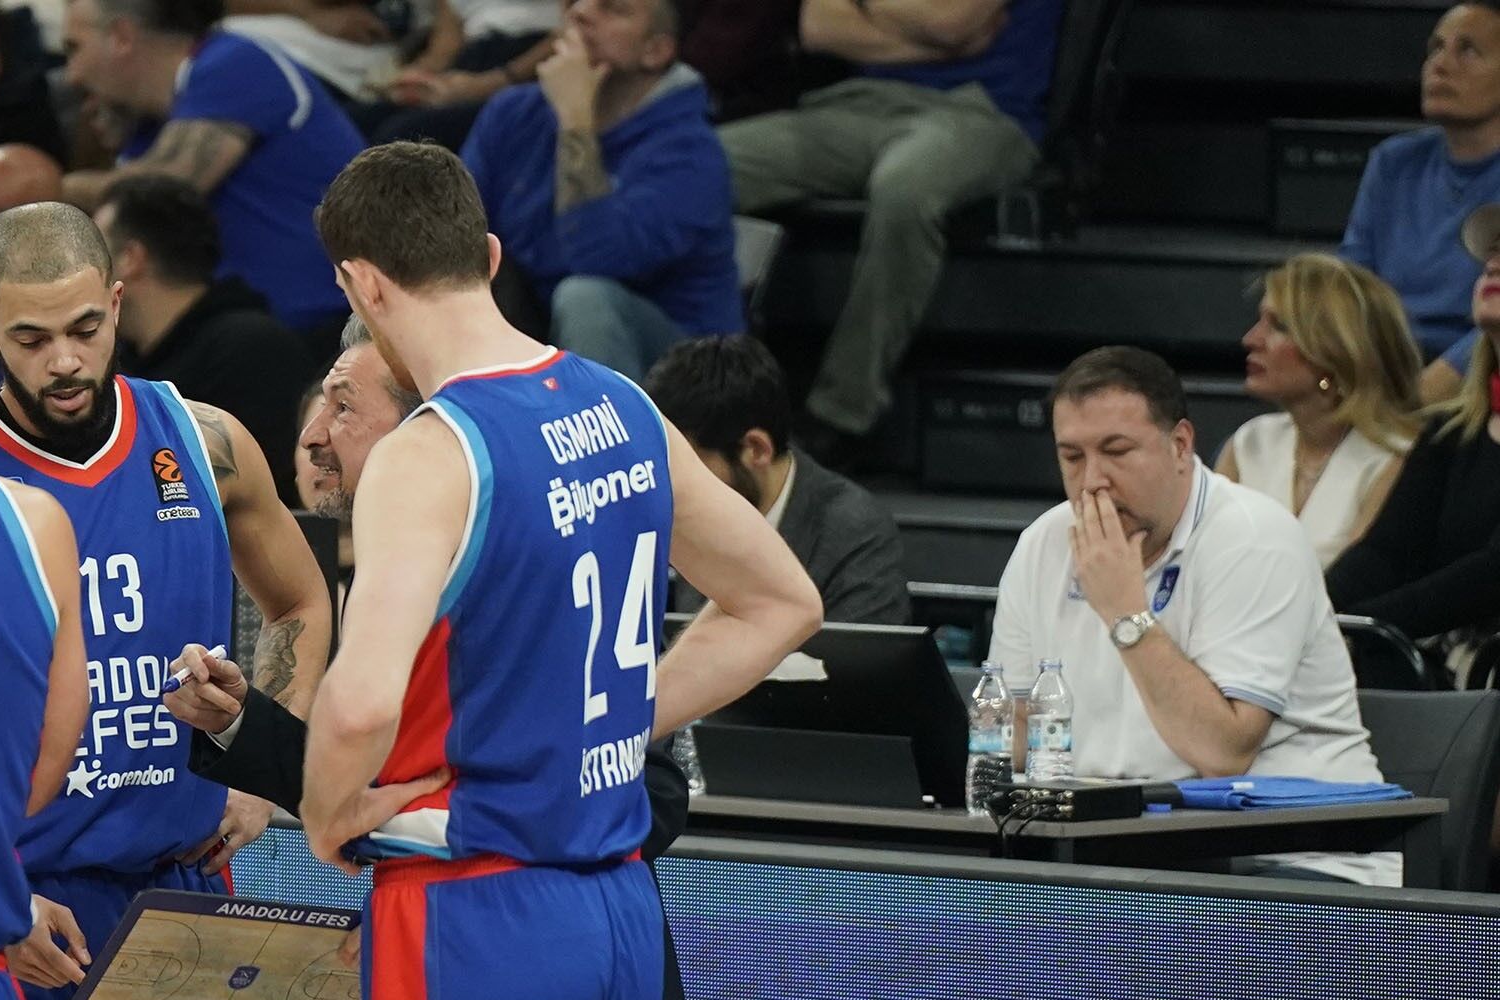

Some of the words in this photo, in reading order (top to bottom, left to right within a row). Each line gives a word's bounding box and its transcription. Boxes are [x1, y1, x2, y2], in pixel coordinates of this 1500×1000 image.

[540, 394, 630, 465] OSMANİ
[547, 460, 656, 537] Bilyoner
[79, 553, 144, 636] 13
[572, 530, 657, 725] 24
[75, 704, 178, 756] FES
[97, 764, 175, 791] corendon
[216, 902, 304, 921] ANADOLU
[305, 911, 351, 928] EFES
